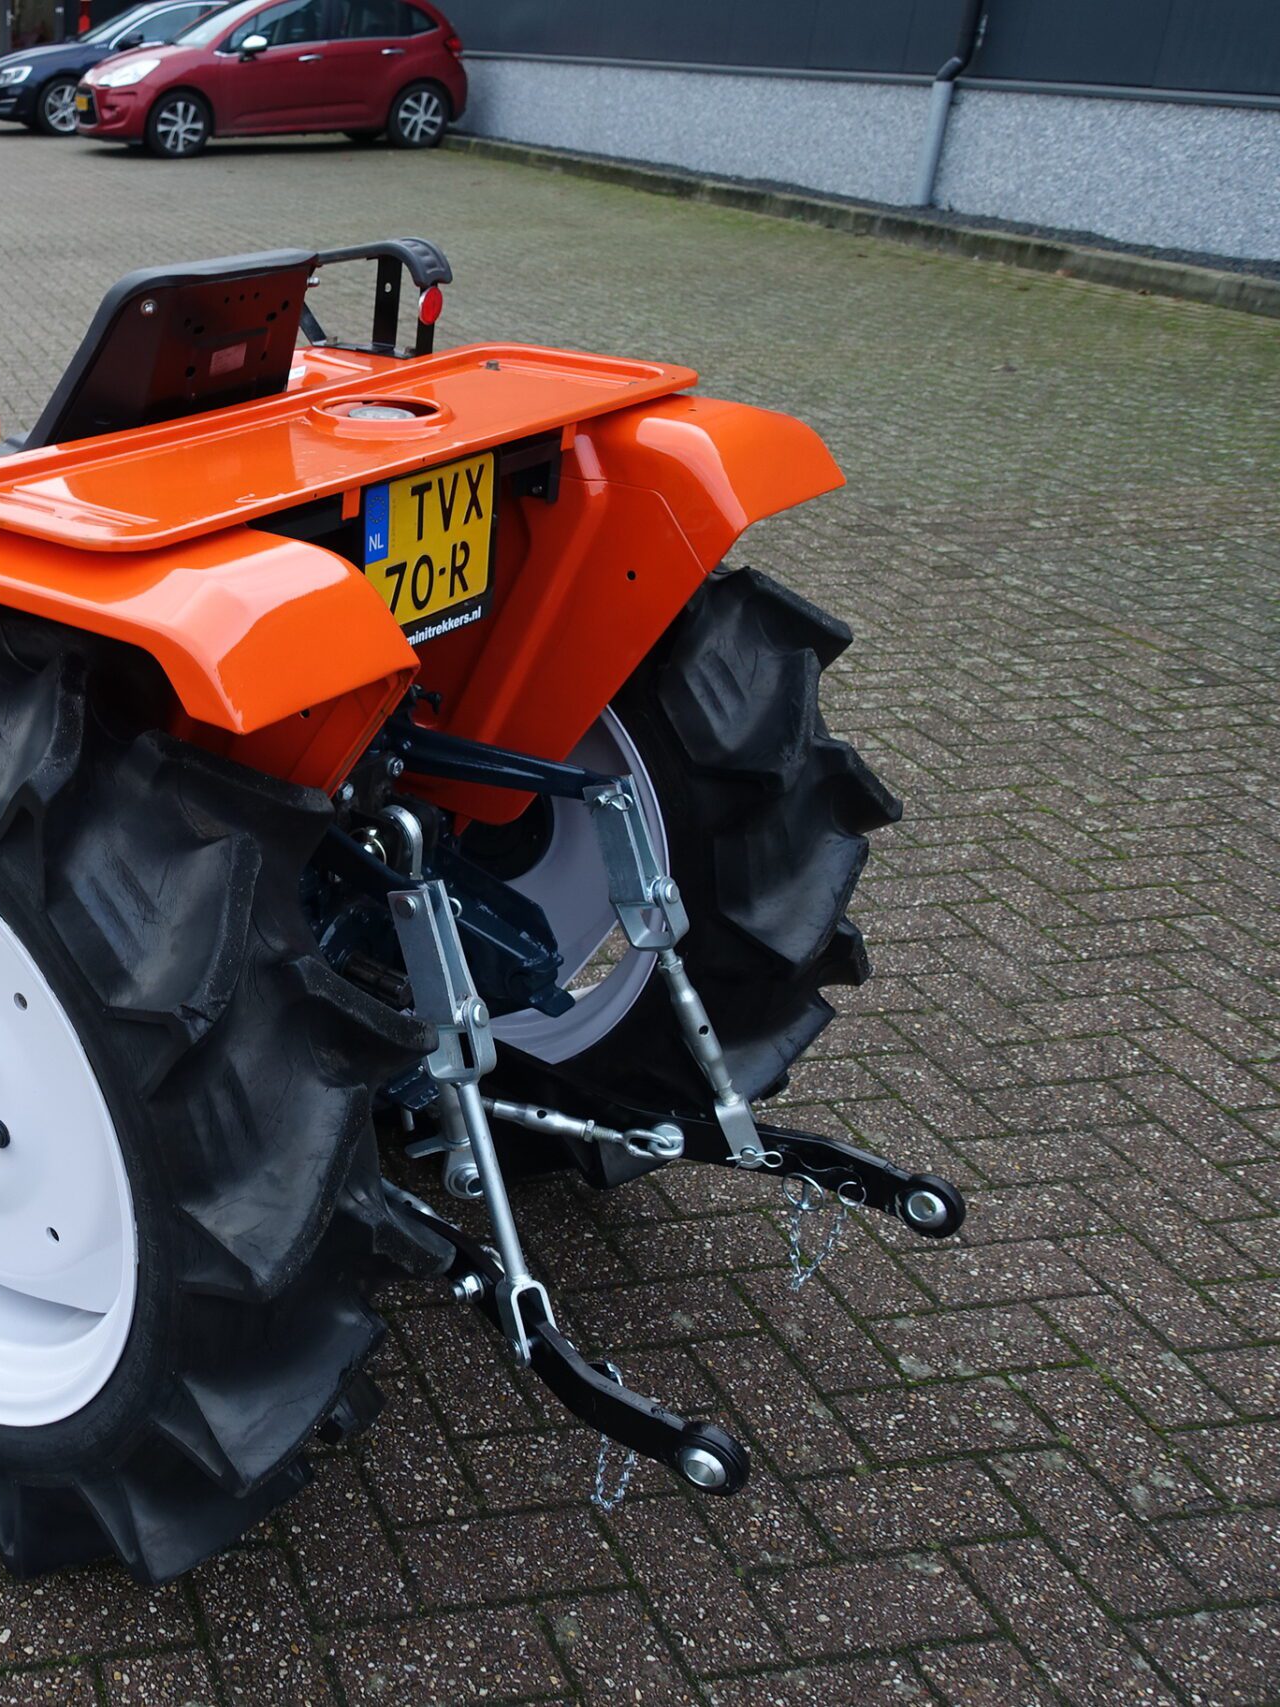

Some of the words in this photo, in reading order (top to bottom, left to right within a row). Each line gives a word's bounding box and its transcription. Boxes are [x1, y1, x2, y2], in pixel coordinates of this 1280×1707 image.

[410, 463, 485, 542] TVX
[368, 532, 384, 552] NL
[384, 540, 471, 616] 70-R
